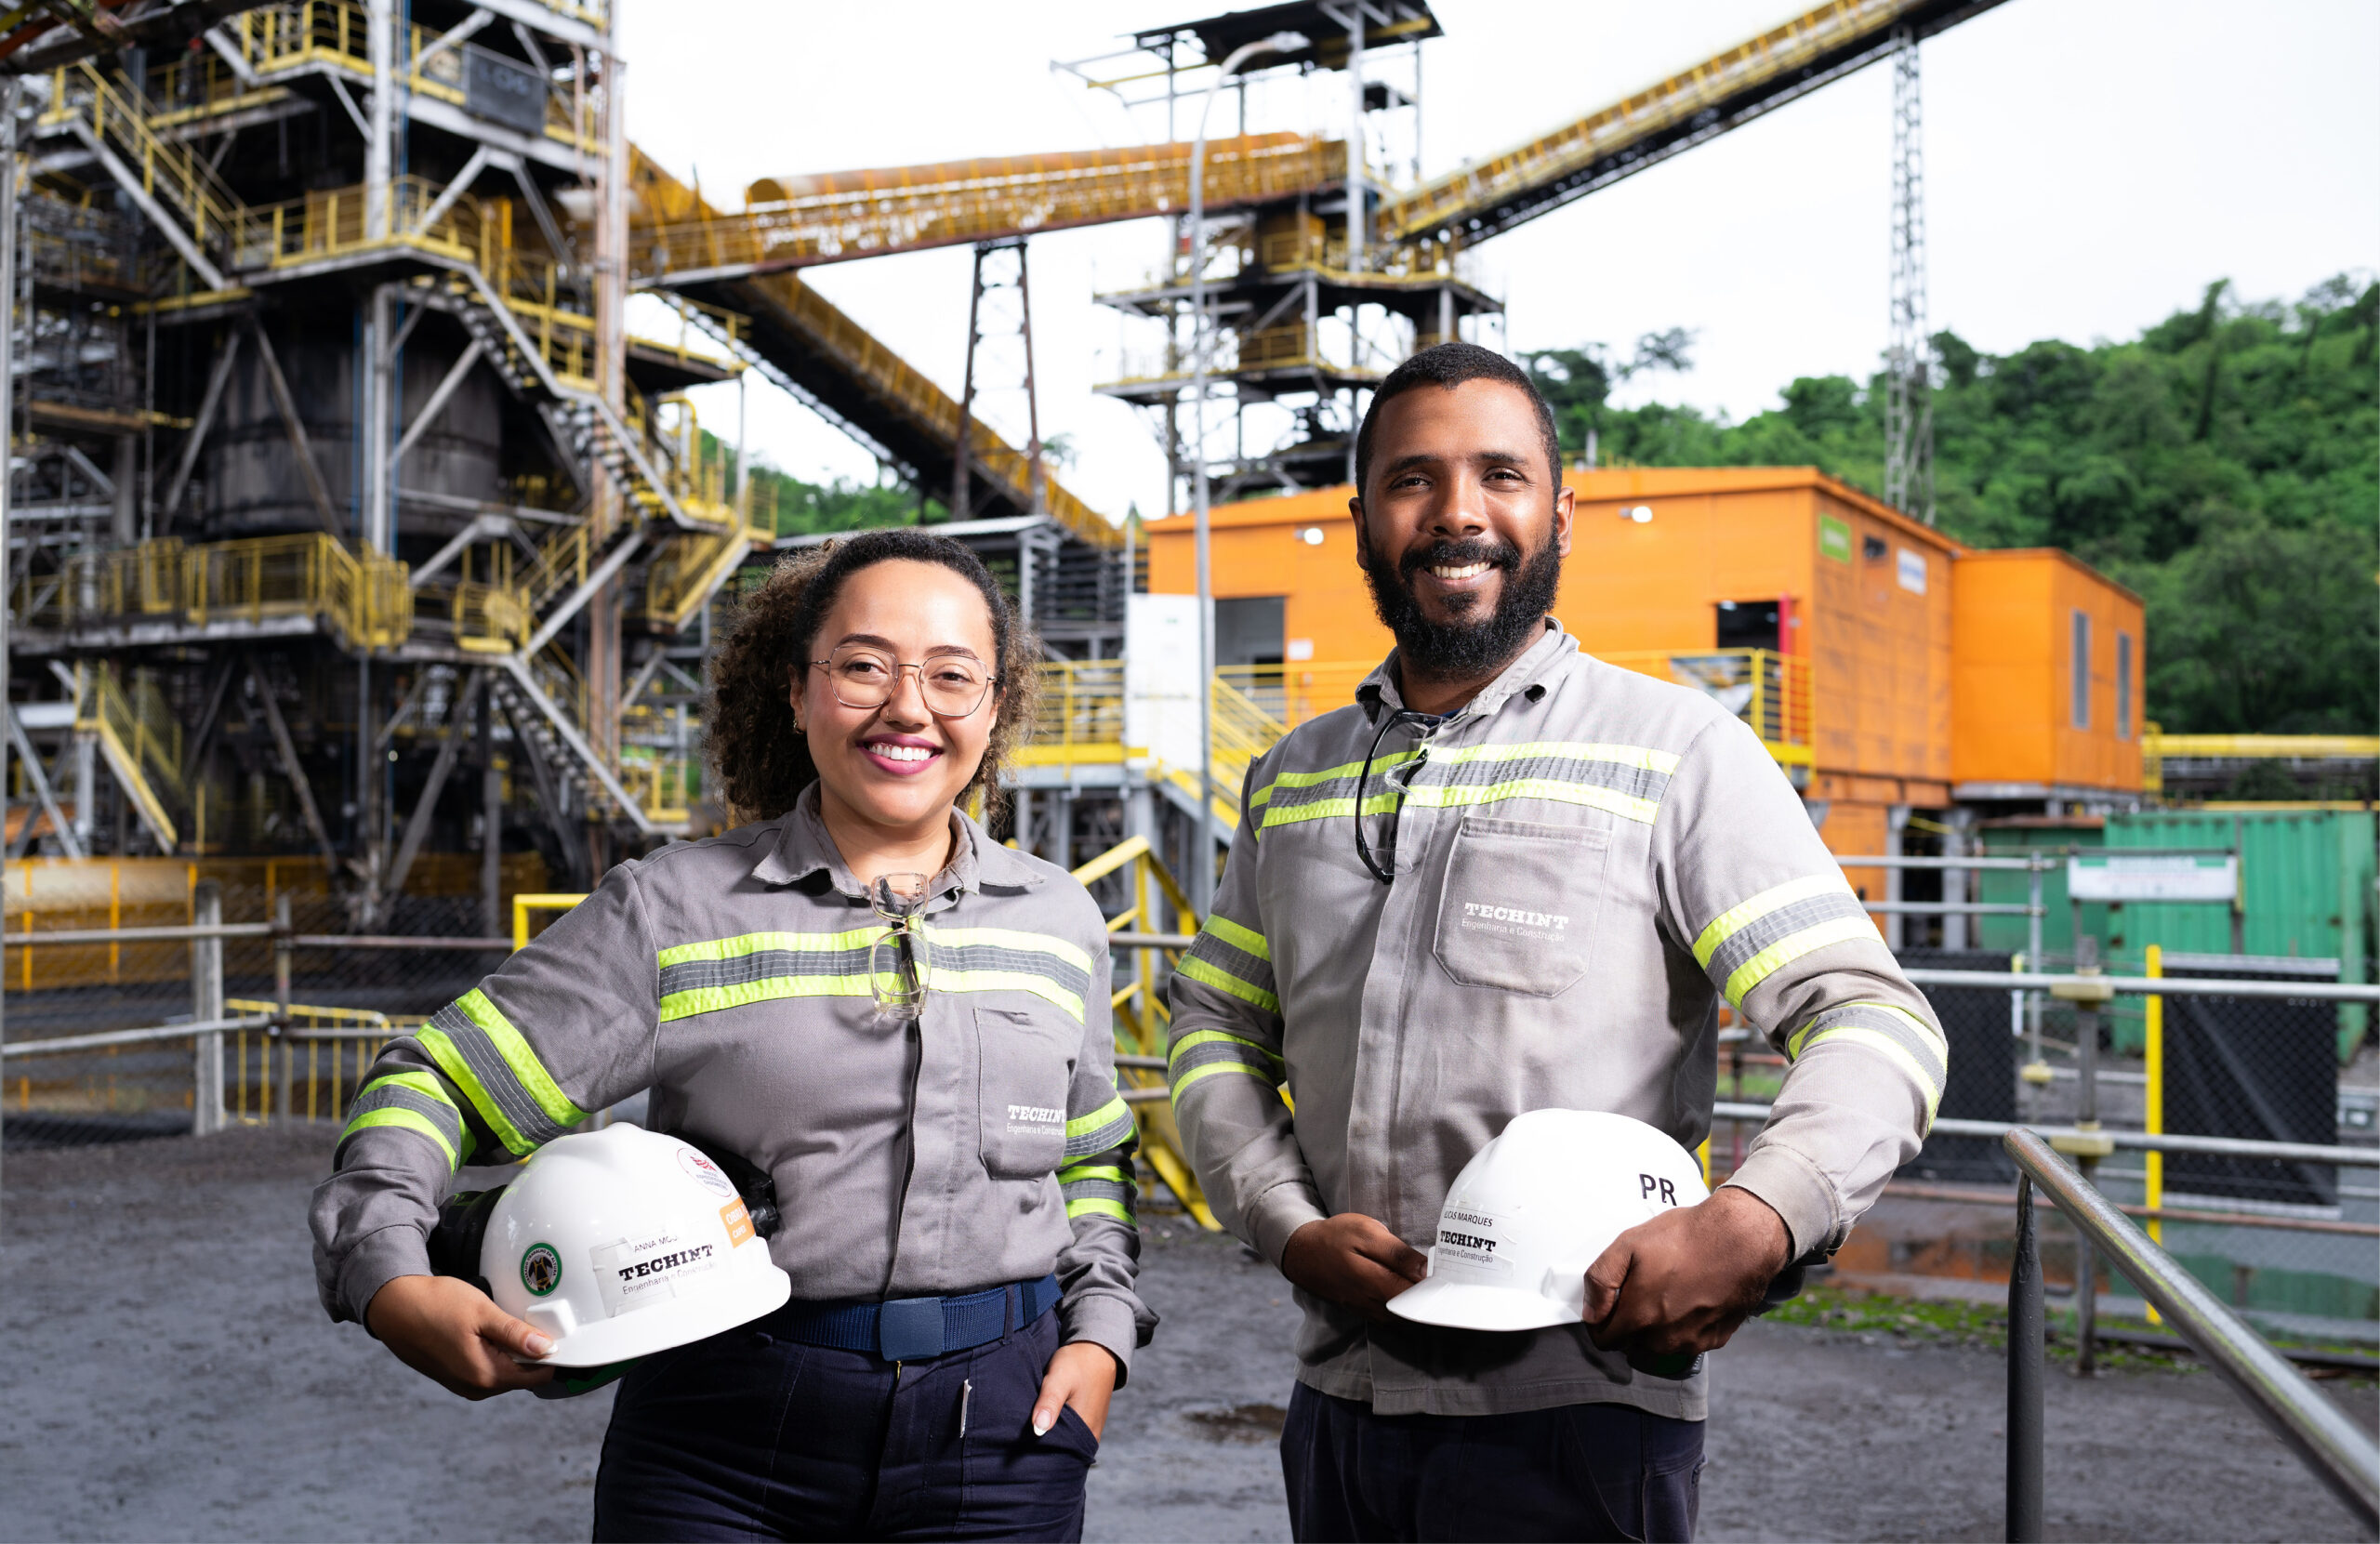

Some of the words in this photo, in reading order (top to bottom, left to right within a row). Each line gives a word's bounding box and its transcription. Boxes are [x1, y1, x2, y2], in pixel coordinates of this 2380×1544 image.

[1464, 902, 1569, 930] TECHINT
[1461, 917, 1507, 933] Engenharia
[1509, 927, 1515, 935] e
[1516, 926, 1565, 943] Construção
[1639, 1173, 1677, 1207] PR
[1458, 1212, 1493, 1227] MARQUES
[634, 1240, 657, 1253] ANNA
[1441, 1230, 1496, 1252] TECHINT
[618, 1244, 713, 1281] TECHINT
[1461, 1249, 1493, 1263] Construção
